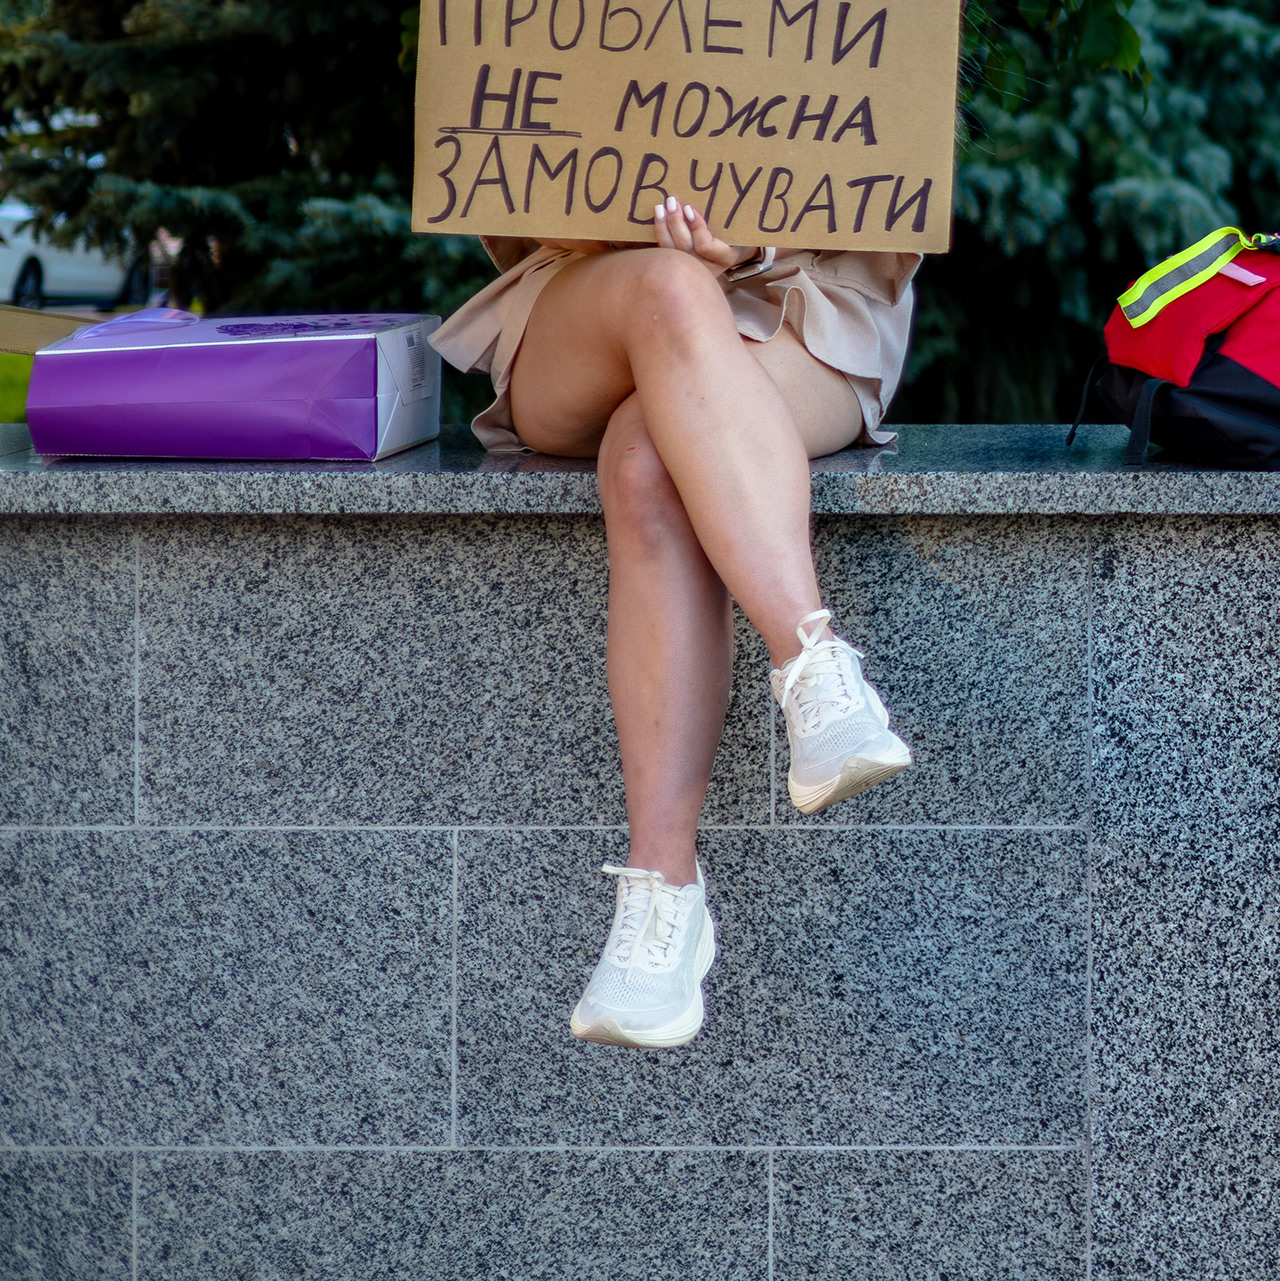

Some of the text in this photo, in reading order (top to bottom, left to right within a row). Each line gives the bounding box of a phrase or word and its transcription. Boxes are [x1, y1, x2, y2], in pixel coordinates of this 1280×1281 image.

[470, 64, 878, 146] НЕ МОЖНА
[427, 135, 933, 234] ЗАМОВЧУВАТИ
